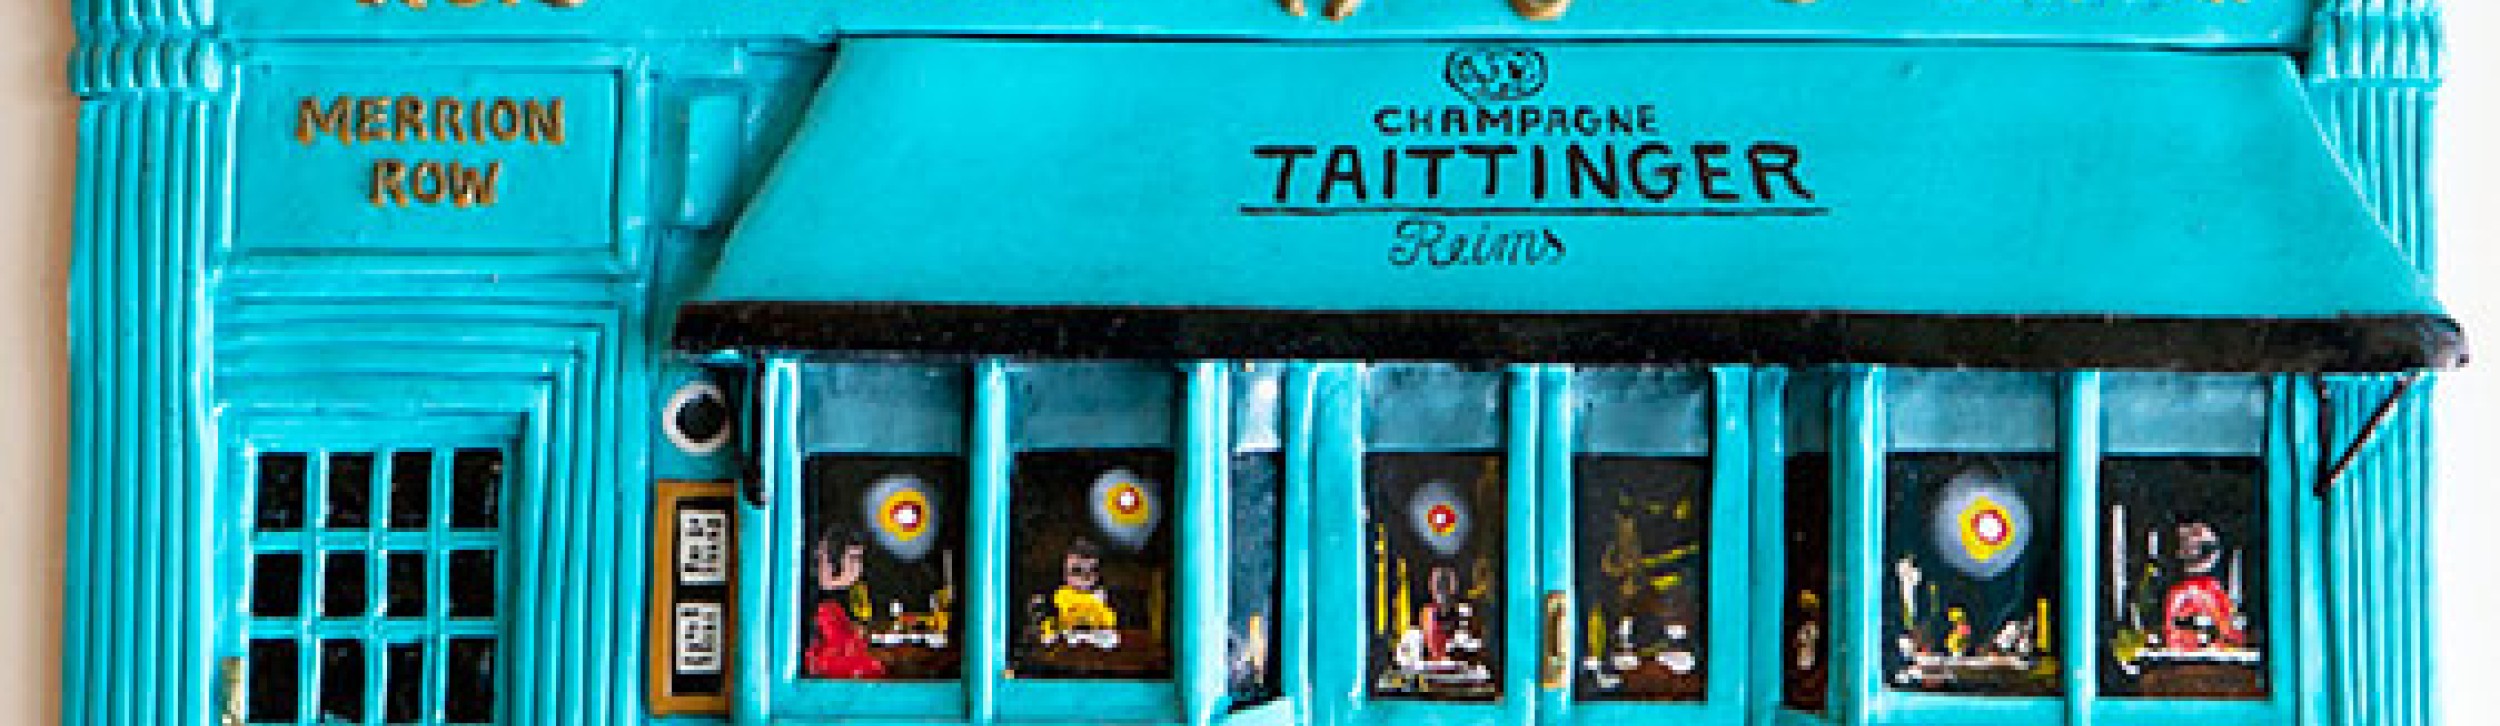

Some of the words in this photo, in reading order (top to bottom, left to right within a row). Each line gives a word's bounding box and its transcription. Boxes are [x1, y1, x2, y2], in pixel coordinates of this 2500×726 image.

[295, 95, 566, 145] MERRION
[1373, 105, 1658, 136] CHAMPAGNE
[368, 158, 501, 208] ROW
[1252, 142, 1816, 204] TAITTINGER
[1387, 216, 1567, 268] Reims
